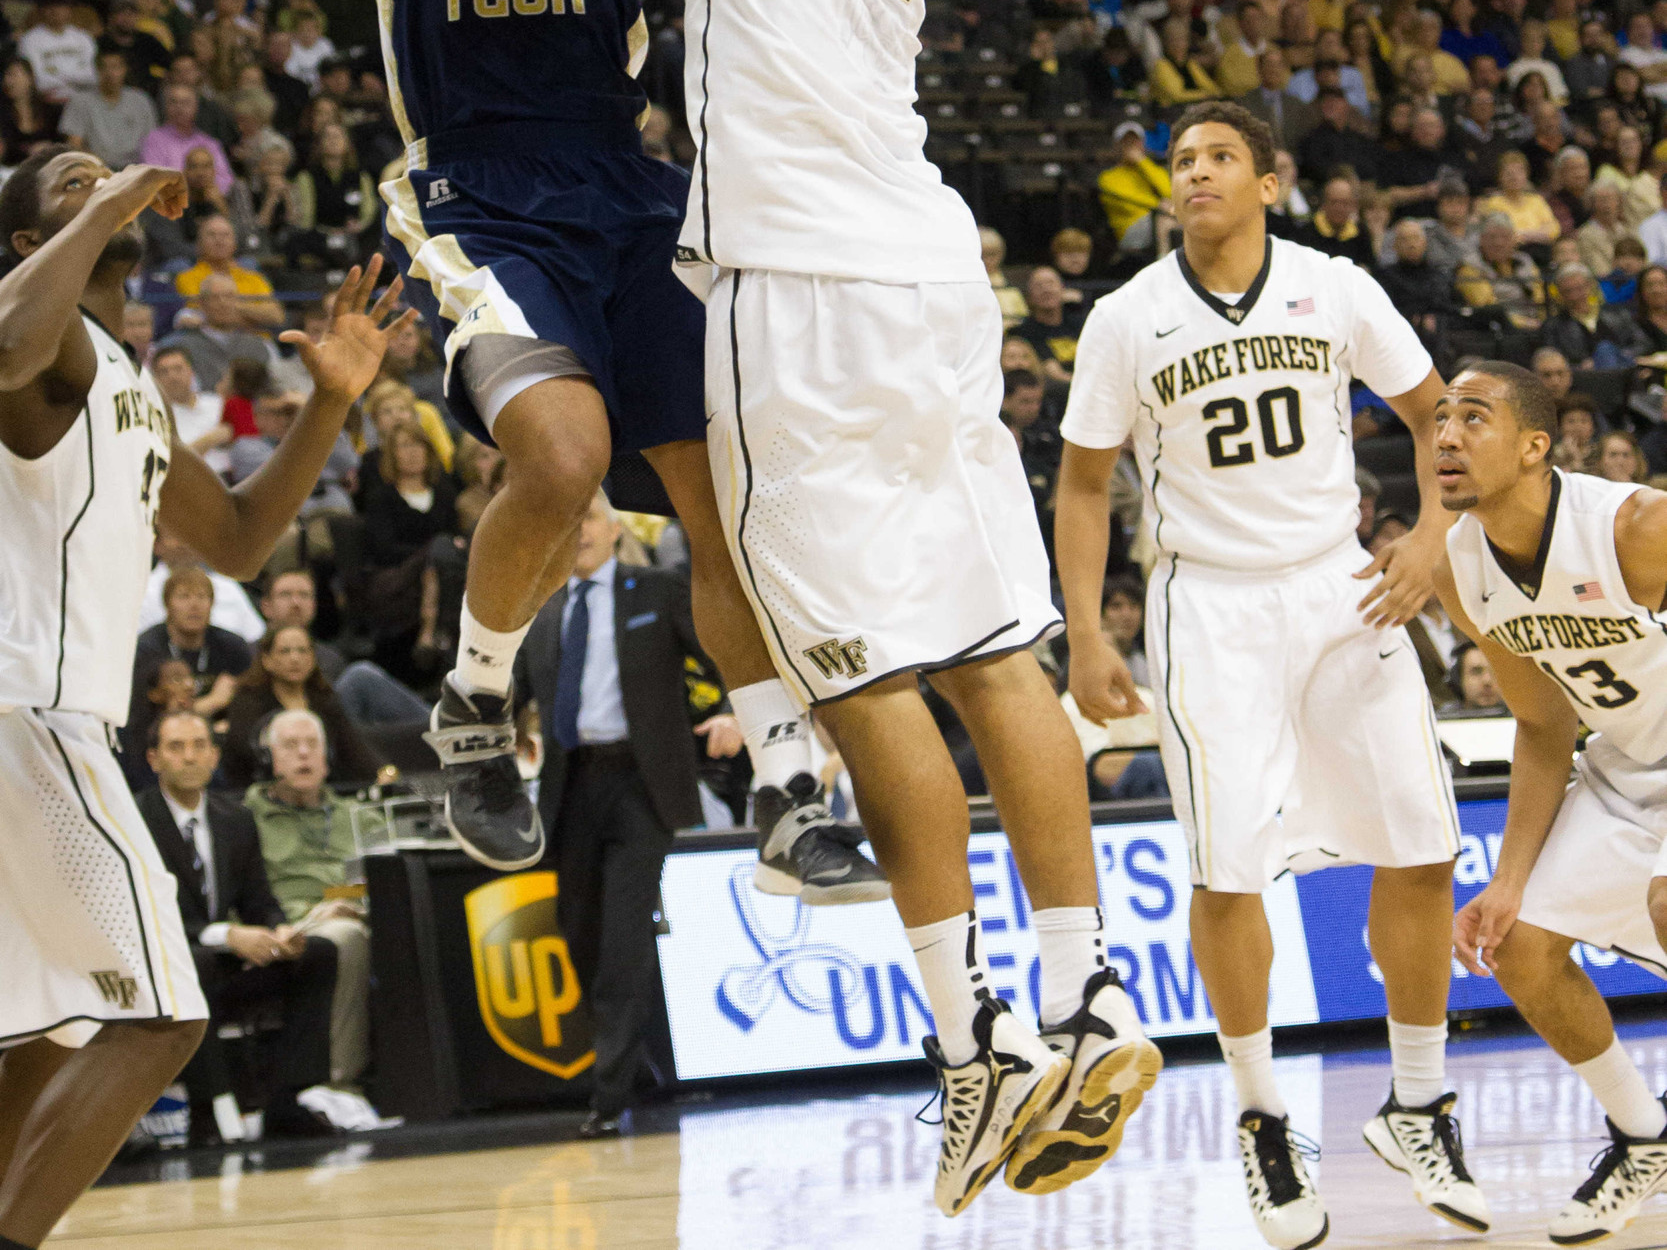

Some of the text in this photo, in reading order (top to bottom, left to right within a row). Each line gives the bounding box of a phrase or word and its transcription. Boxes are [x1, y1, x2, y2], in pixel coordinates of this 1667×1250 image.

[1152, 334, 1331, 408] WAKE FOREST
[1202, 385, 1305, 468] 20
[802, 635, 868, 679] WF
[1535, 614, 1646, 649] FOREST
[1540, 658, 1640, 710] 13
[89, 970, 139, 1010] WF
[486, 937, 583, 1048] up
